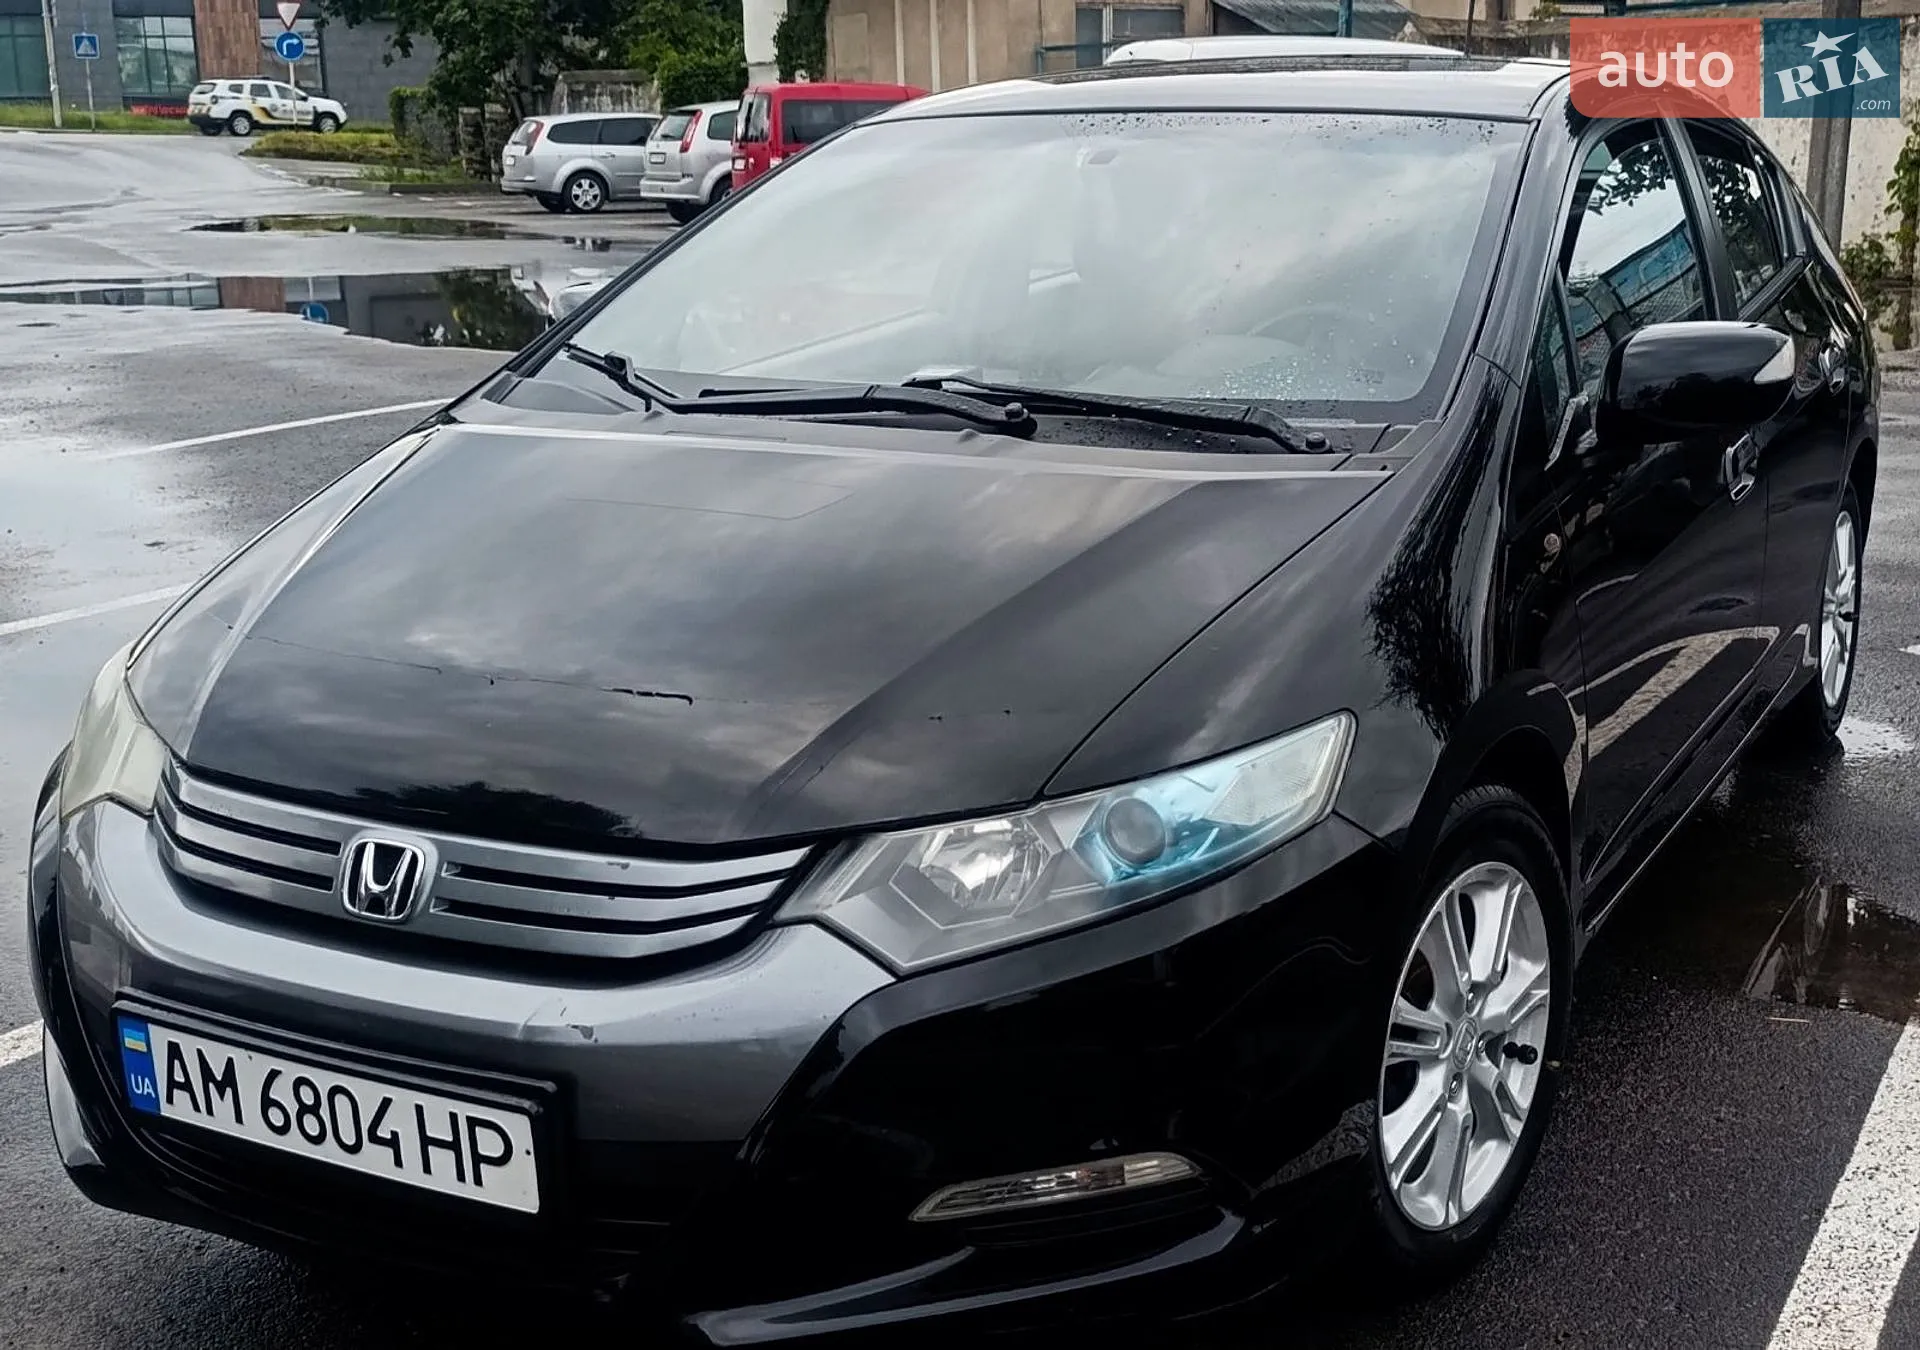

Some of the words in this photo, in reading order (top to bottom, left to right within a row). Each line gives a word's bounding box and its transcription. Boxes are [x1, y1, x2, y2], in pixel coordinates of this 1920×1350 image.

[131, 1074, 156, 1098] UA
[165, 1040, 244, 1125] AM
[260, 1068, 403, 1168] 6804
[415, 1103, 514, 1187] HP
